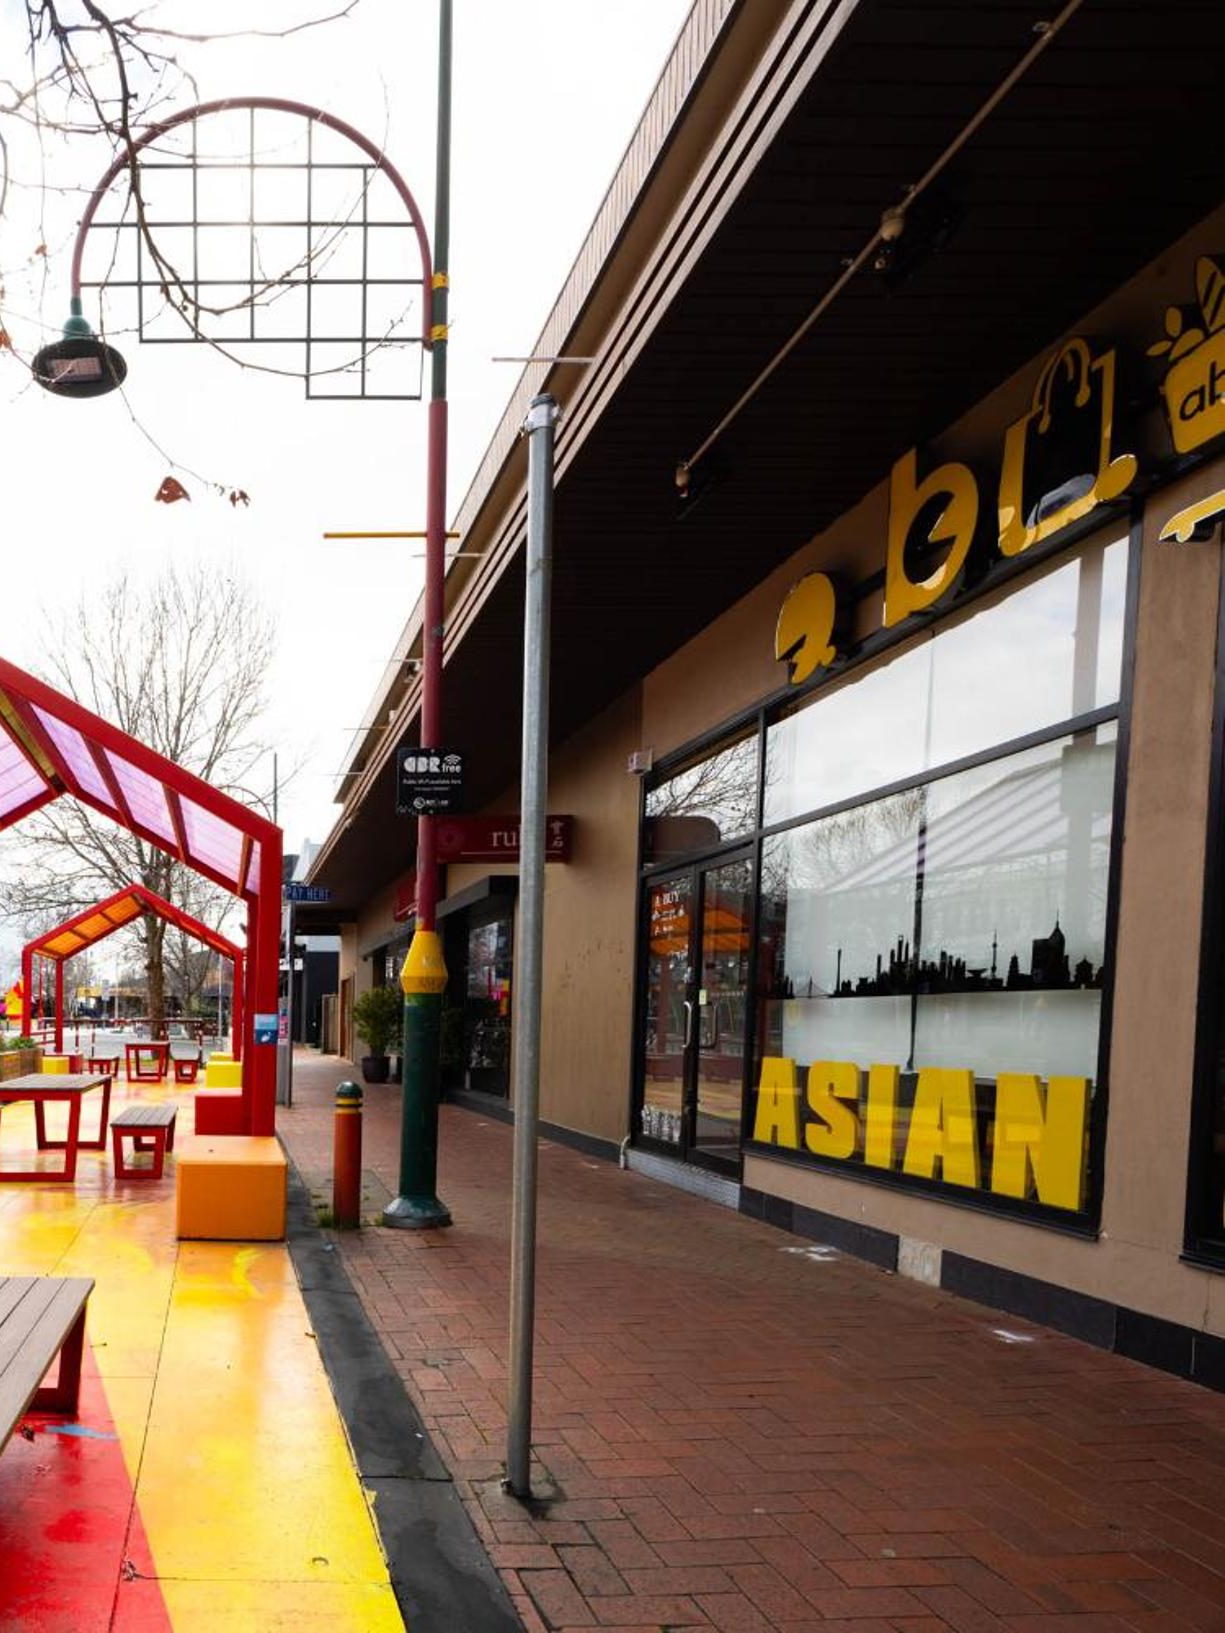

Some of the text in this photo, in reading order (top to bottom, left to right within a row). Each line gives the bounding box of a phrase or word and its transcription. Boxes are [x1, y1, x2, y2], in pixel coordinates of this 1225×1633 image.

[404, 757, 462, 773] CBR free
[752, 1056, 1092, 1212] ASIAN
